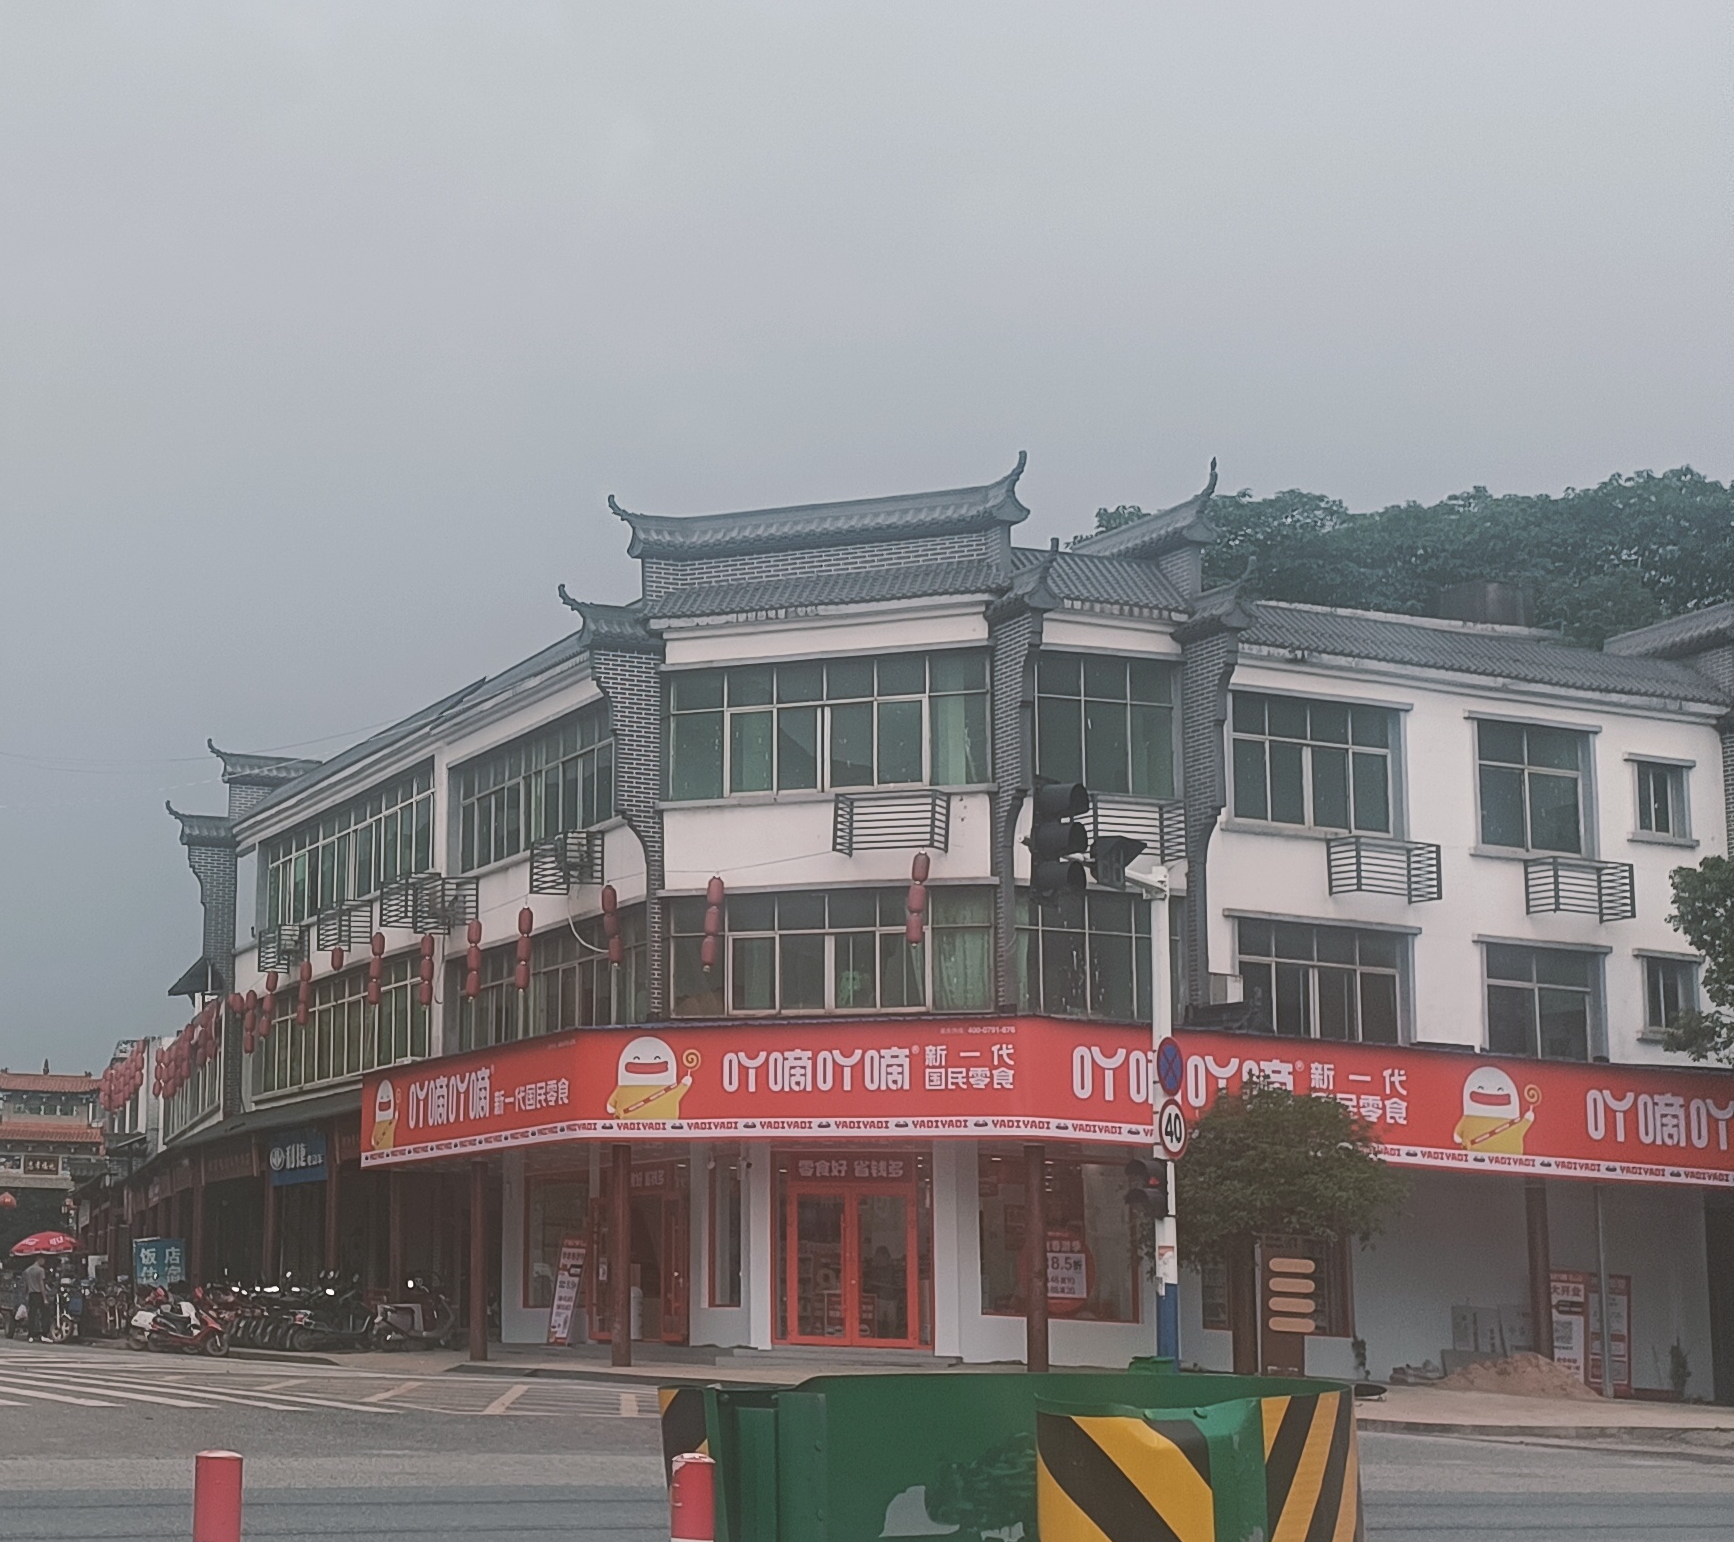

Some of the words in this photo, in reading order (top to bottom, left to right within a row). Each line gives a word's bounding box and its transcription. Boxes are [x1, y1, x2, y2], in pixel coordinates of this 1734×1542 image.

[924, 1044, 1015, 1067] 新一代
[924, 1066, 1015, 1090] 国民零食
[1310, 1061, 1408, 1096] 新一代
[493, 1077, 570, 1116] 新一代国民零食
[1310, 1091, 1408, 1125] 民零食
[1164, 1112, 1183, 1144] 40
[798, 1160, 848, 1177] 零食好
[139, 1247, 181, 1265] 饭店
